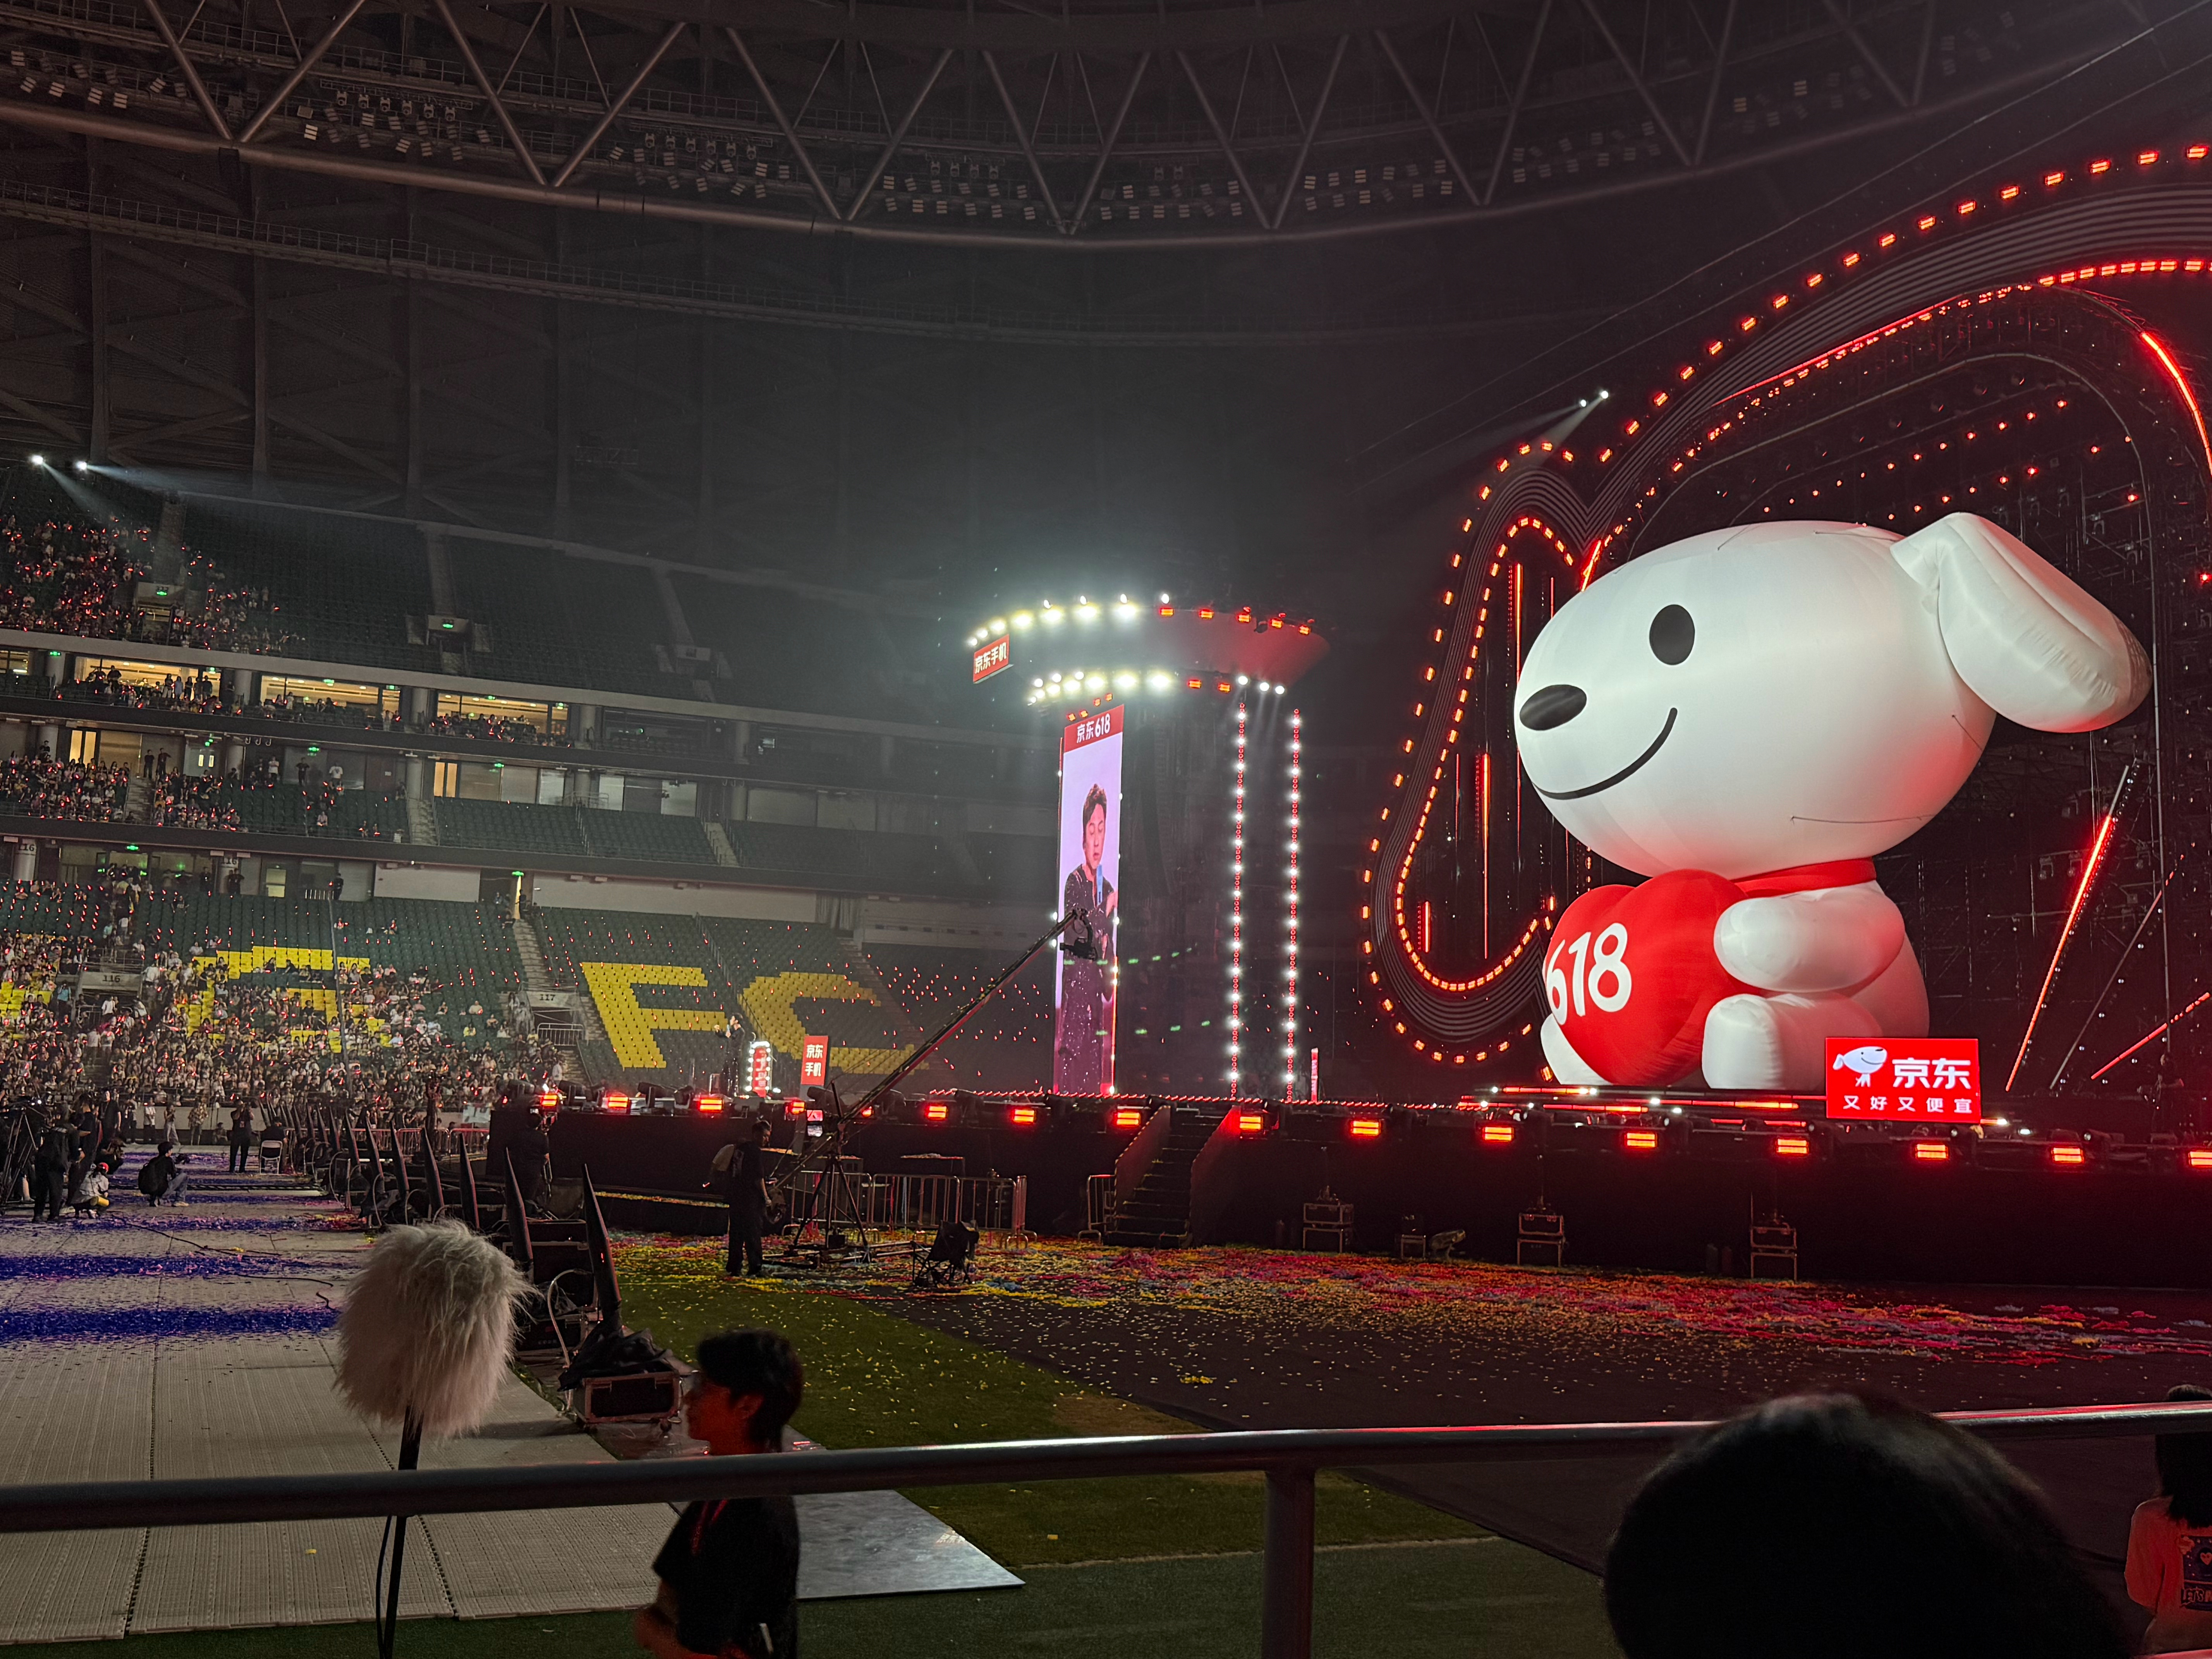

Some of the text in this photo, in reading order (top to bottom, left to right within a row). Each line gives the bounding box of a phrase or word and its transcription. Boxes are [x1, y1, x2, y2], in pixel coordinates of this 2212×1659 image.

[975, 643, 1007, 674] 京东手机
[1077, 714, 1110, 744] 京东618
[1546, 923, 1632, 1025] 618
[581, 962, 929, 1075] FC
[806, 1044, 824, 1058] 京东
[805, 1062, 821, 1077] 手机
[1892, 1058, 1971, 1089] 京东
[1843, 1095, 1972, 1113] 又好又便宜
